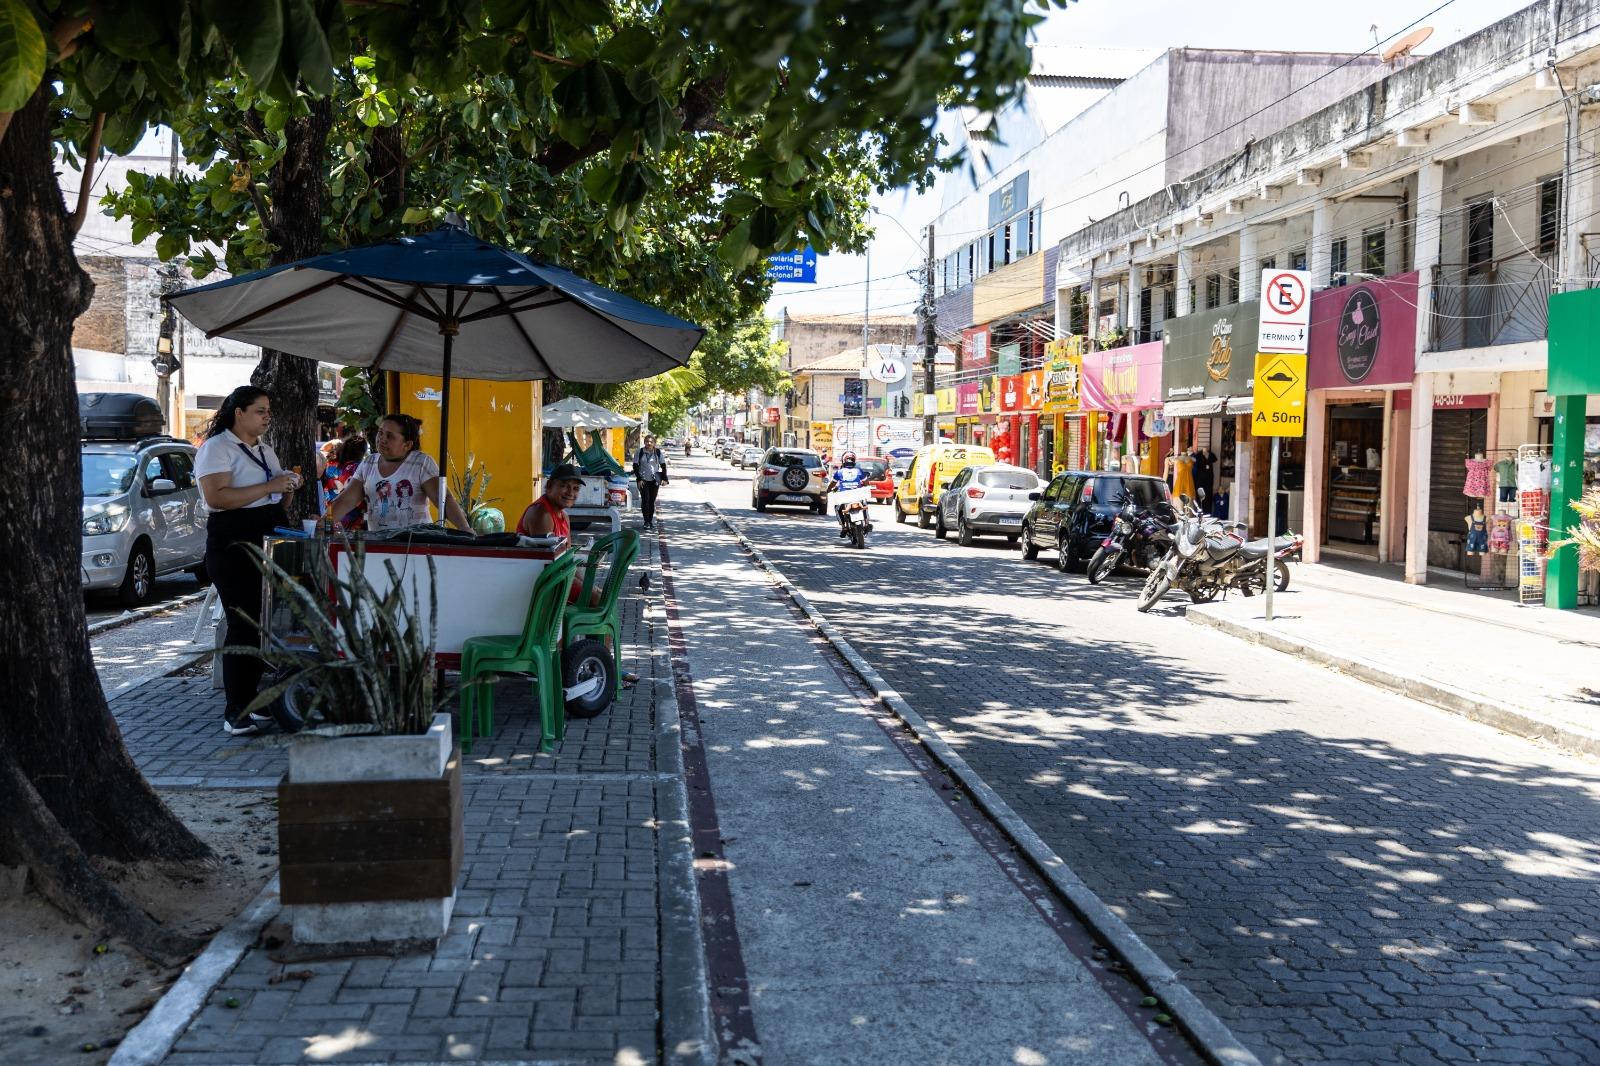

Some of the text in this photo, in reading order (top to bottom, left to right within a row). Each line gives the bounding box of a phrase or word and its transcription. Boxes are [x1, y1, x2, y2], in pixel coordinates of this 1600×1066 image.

[1262, 333, 1297, 342] TERMINO
[1255, 411, 1301, 424] A 50m
